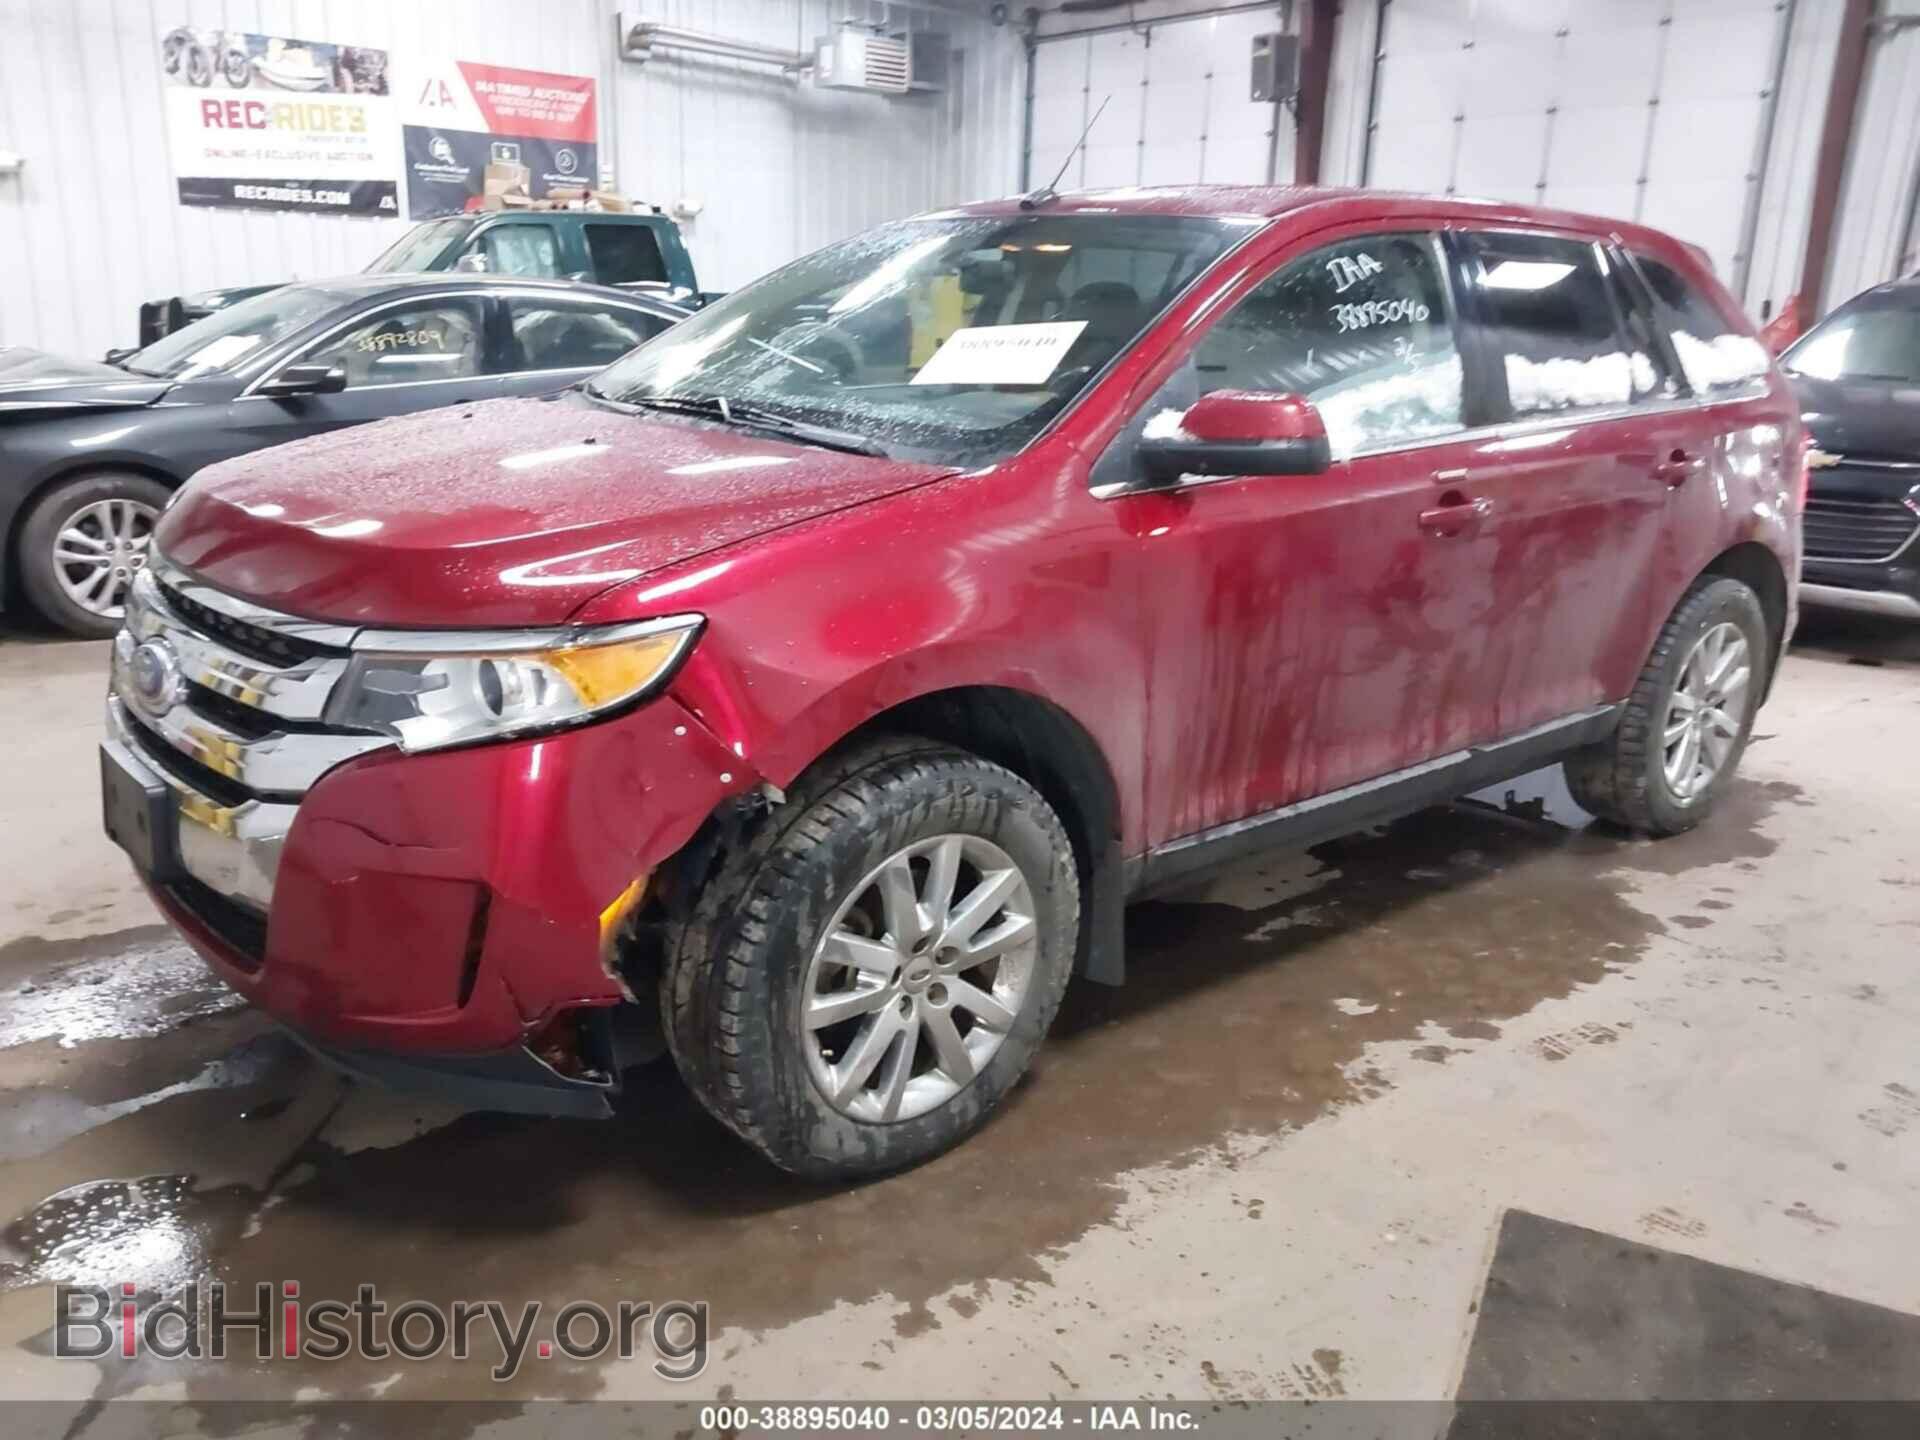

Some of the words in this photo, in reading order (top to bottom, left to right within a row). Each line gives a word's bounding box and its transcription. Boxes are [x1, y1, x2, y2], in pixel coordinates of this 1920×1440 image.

[200, 99, 266, 130] REC
[233, 185, 351, 206] RECRIDES.COM
[1328, 297, 1430, 334] 38895040
[356, 330, 445, 353] 38892809
